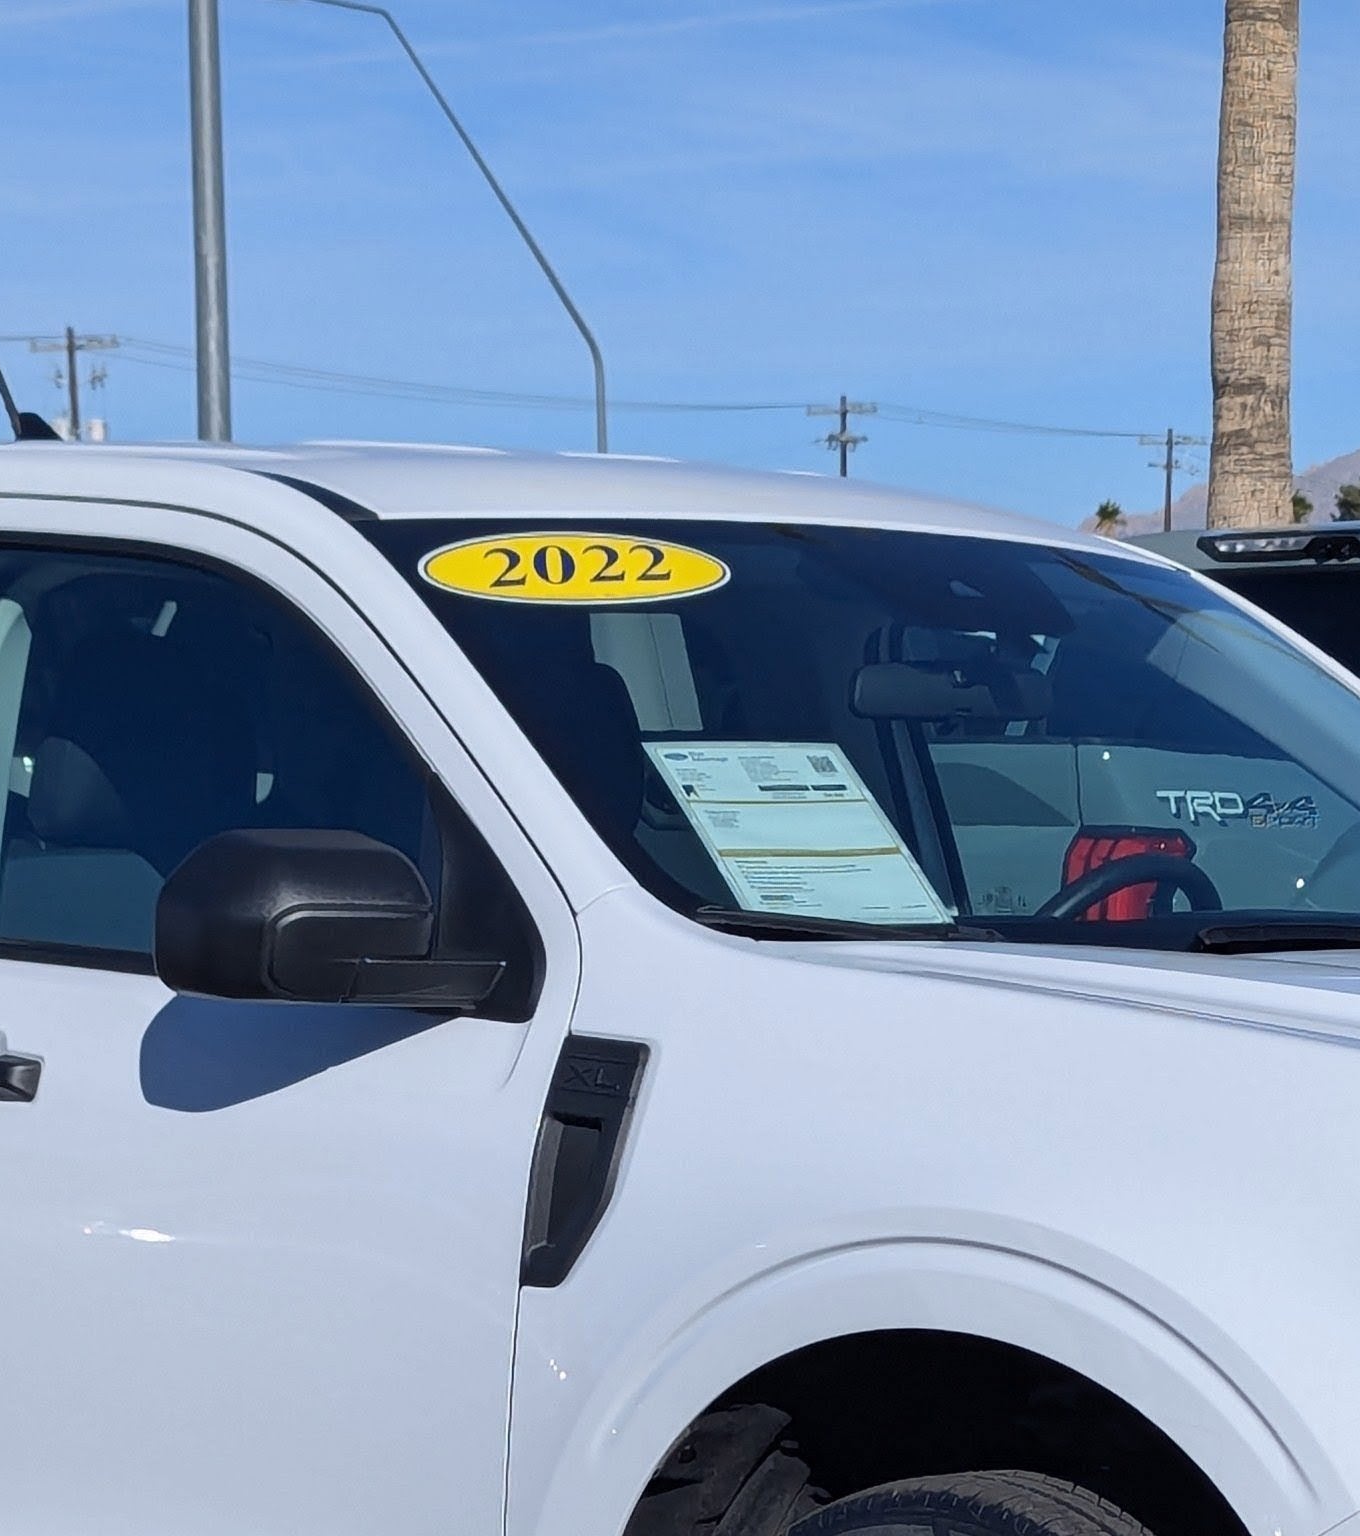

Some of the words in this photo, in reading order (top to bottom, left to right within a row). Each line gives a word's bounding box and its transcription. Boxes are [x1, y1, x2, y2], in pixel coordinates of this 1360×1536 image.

[483, 545, 672, 588] 2022
[1156, 790, 1246, 827] TRD
[563, 1063, 621, 1092] XL
